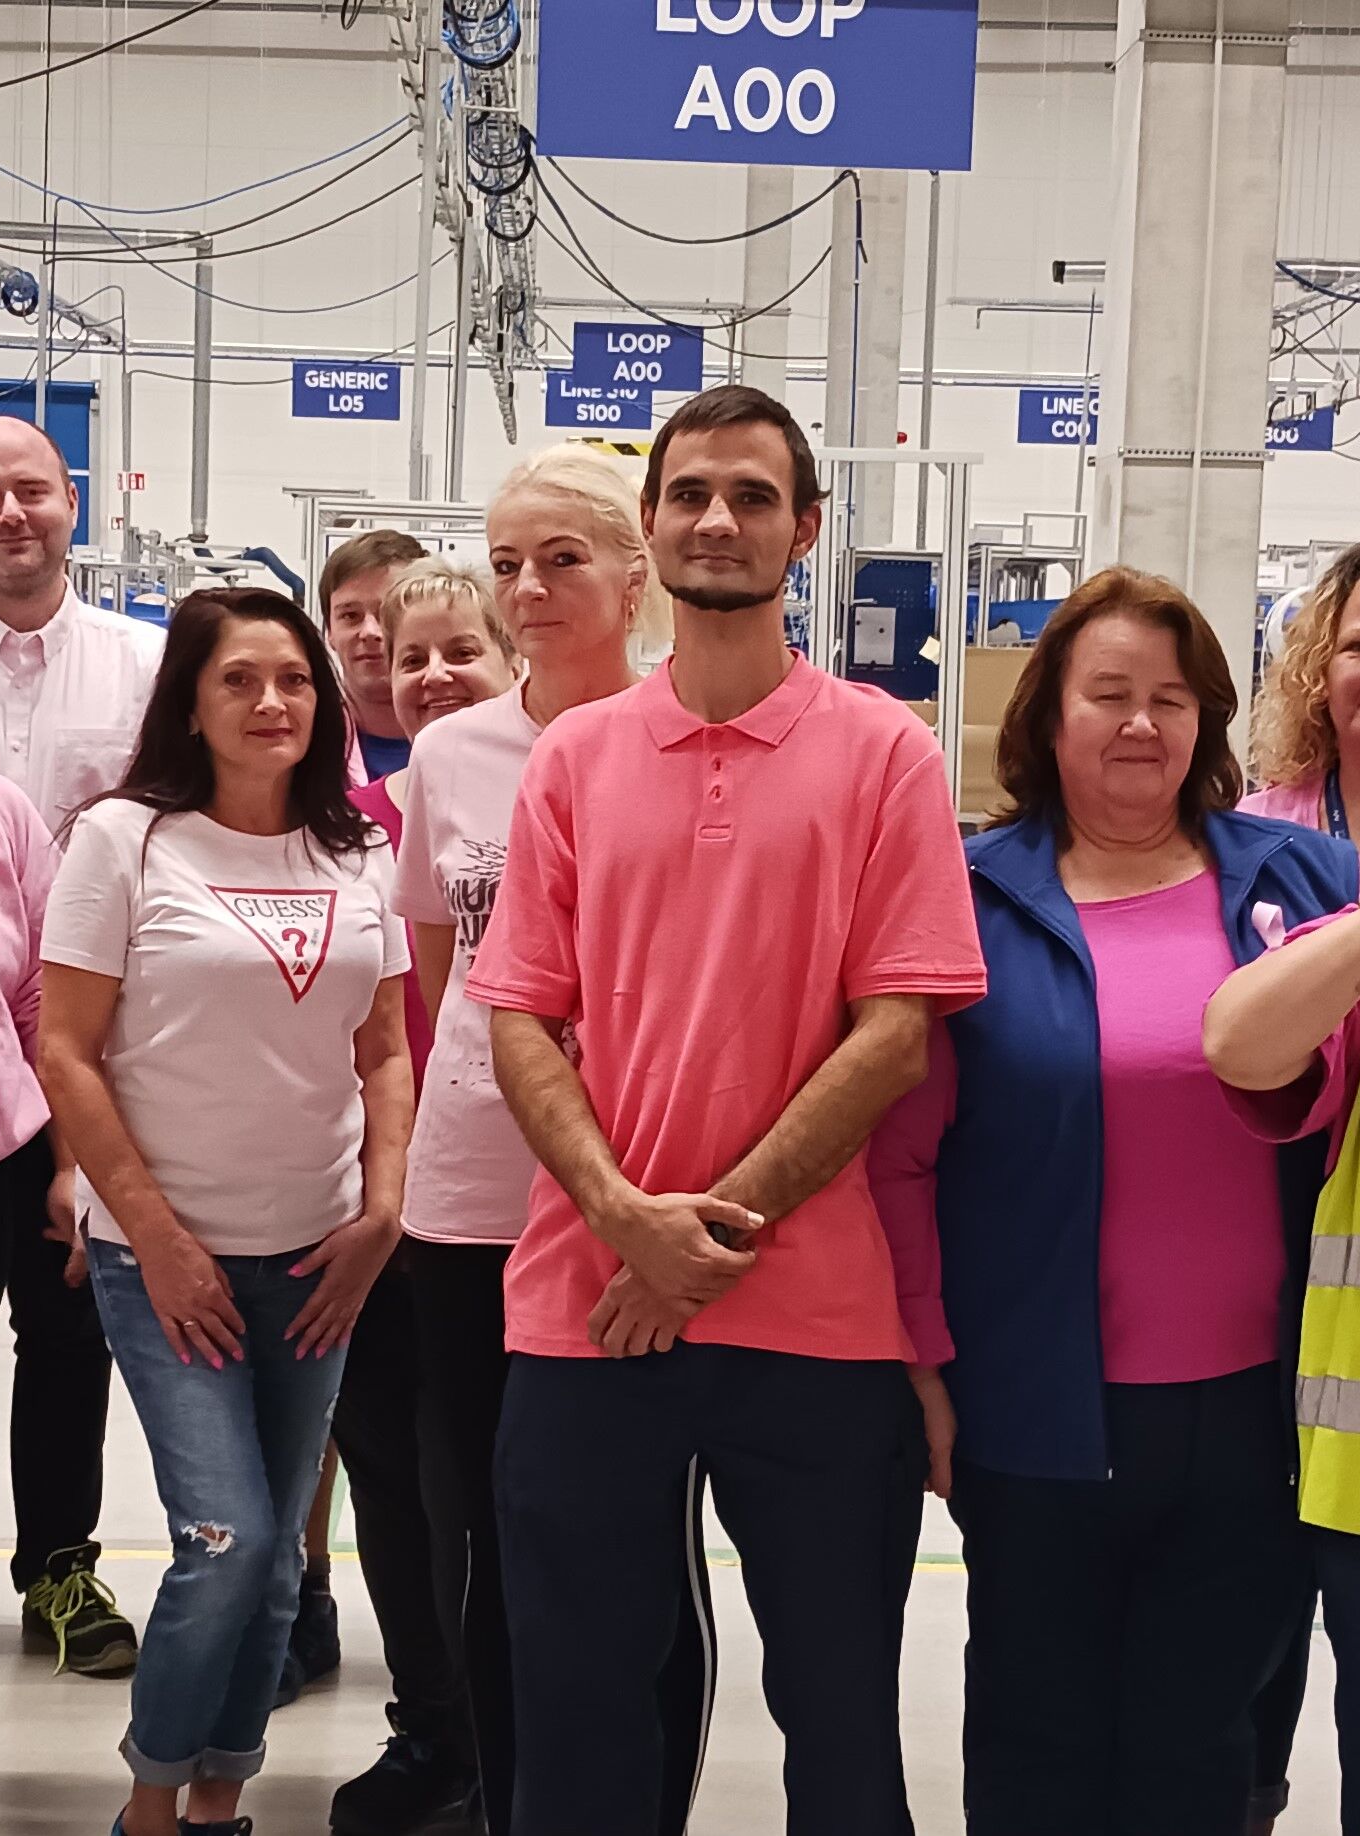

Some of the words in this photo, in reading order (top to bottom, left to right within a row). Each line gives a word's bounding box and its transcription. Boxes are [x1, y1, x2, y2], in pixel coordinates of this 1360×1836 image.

[673, 64, 836, 135] A00
[607, 332, 671, 355] LOOP
[304, 369, 389, 391] GENERIC
[612, 360, 663, 383] A00
[328, 393, 364, 413] L05
[576, 403, 621, 422] S100
[1042, 396, 1084, 415] LINE
[1051, 420, 1091, 438] C00
[233, 897, 324, 918] GUESS
